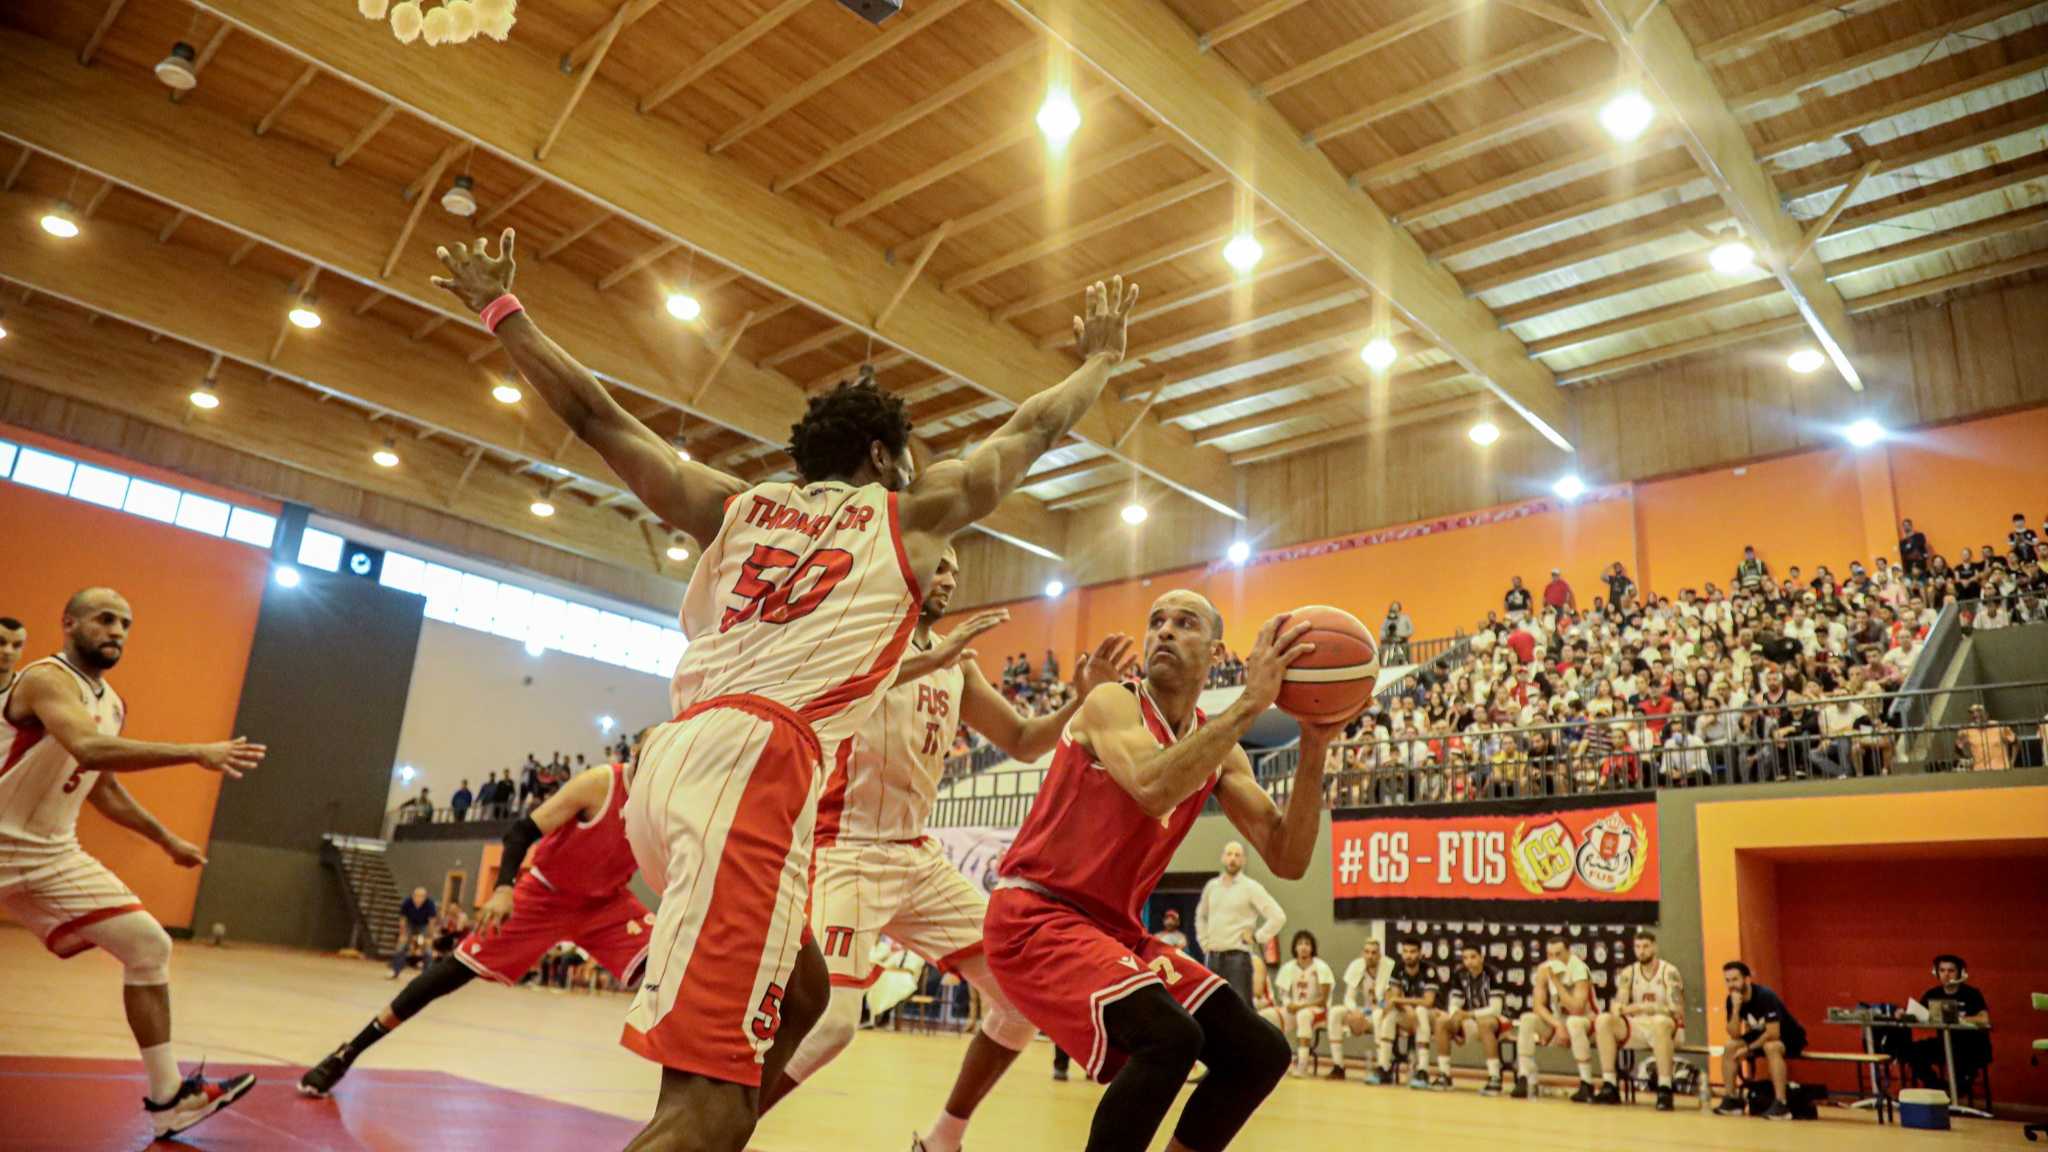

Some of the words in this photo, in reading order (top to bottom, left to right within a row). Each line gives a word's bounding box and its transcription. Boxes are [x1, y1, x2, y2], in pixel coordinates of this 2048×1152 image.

[745, 494, 832, 540] THOMA
[836, 504, 874, 532] JR
[719, 544, 854, 633] 50
[916, 683, 949, 717] FUS
[824, 926, 855, 957] 11
